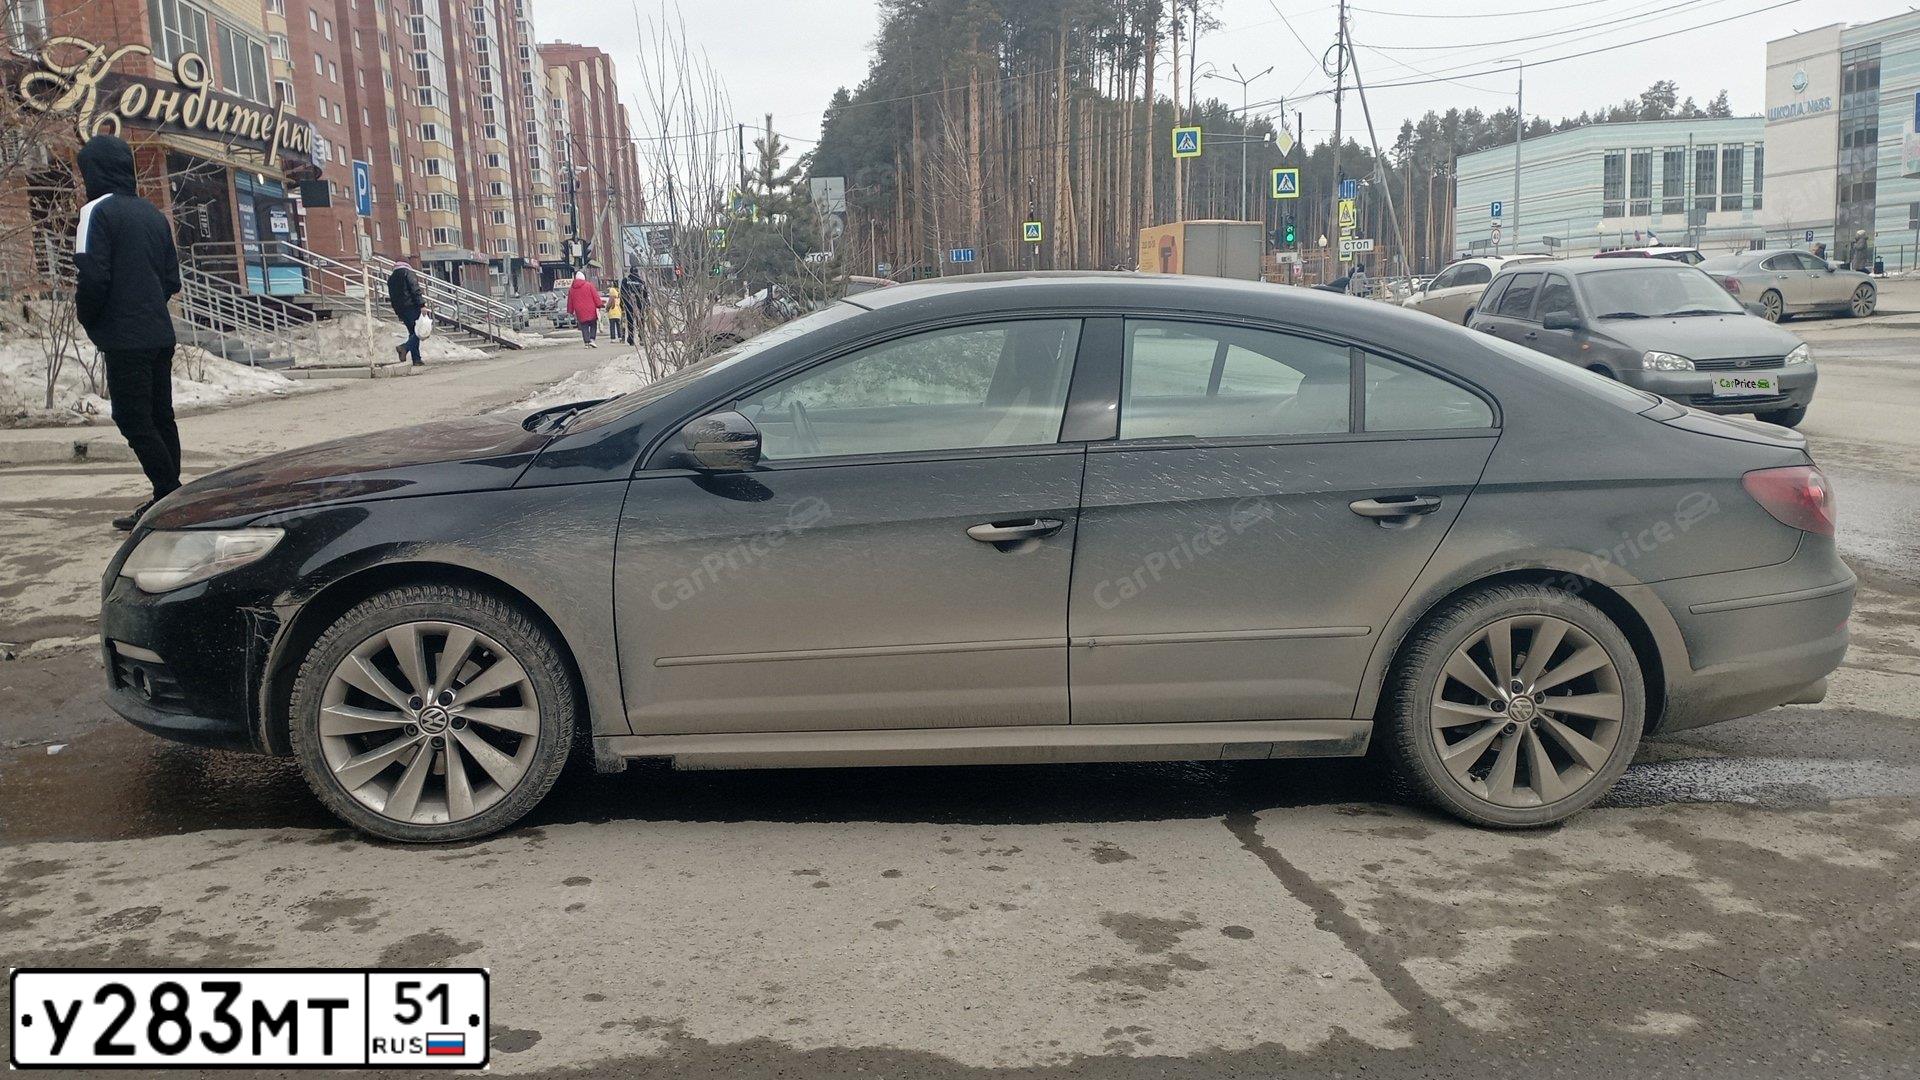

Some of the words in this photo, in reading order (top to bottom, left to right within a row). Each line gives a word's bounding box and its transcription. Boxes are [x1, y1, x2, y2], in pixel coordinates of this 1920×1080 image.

[20, 36, 312, 166] Кондитерка
[1767, 102, 1805, 122] ШКОЛА
[1344, 241, 1369, 250] СТОП
